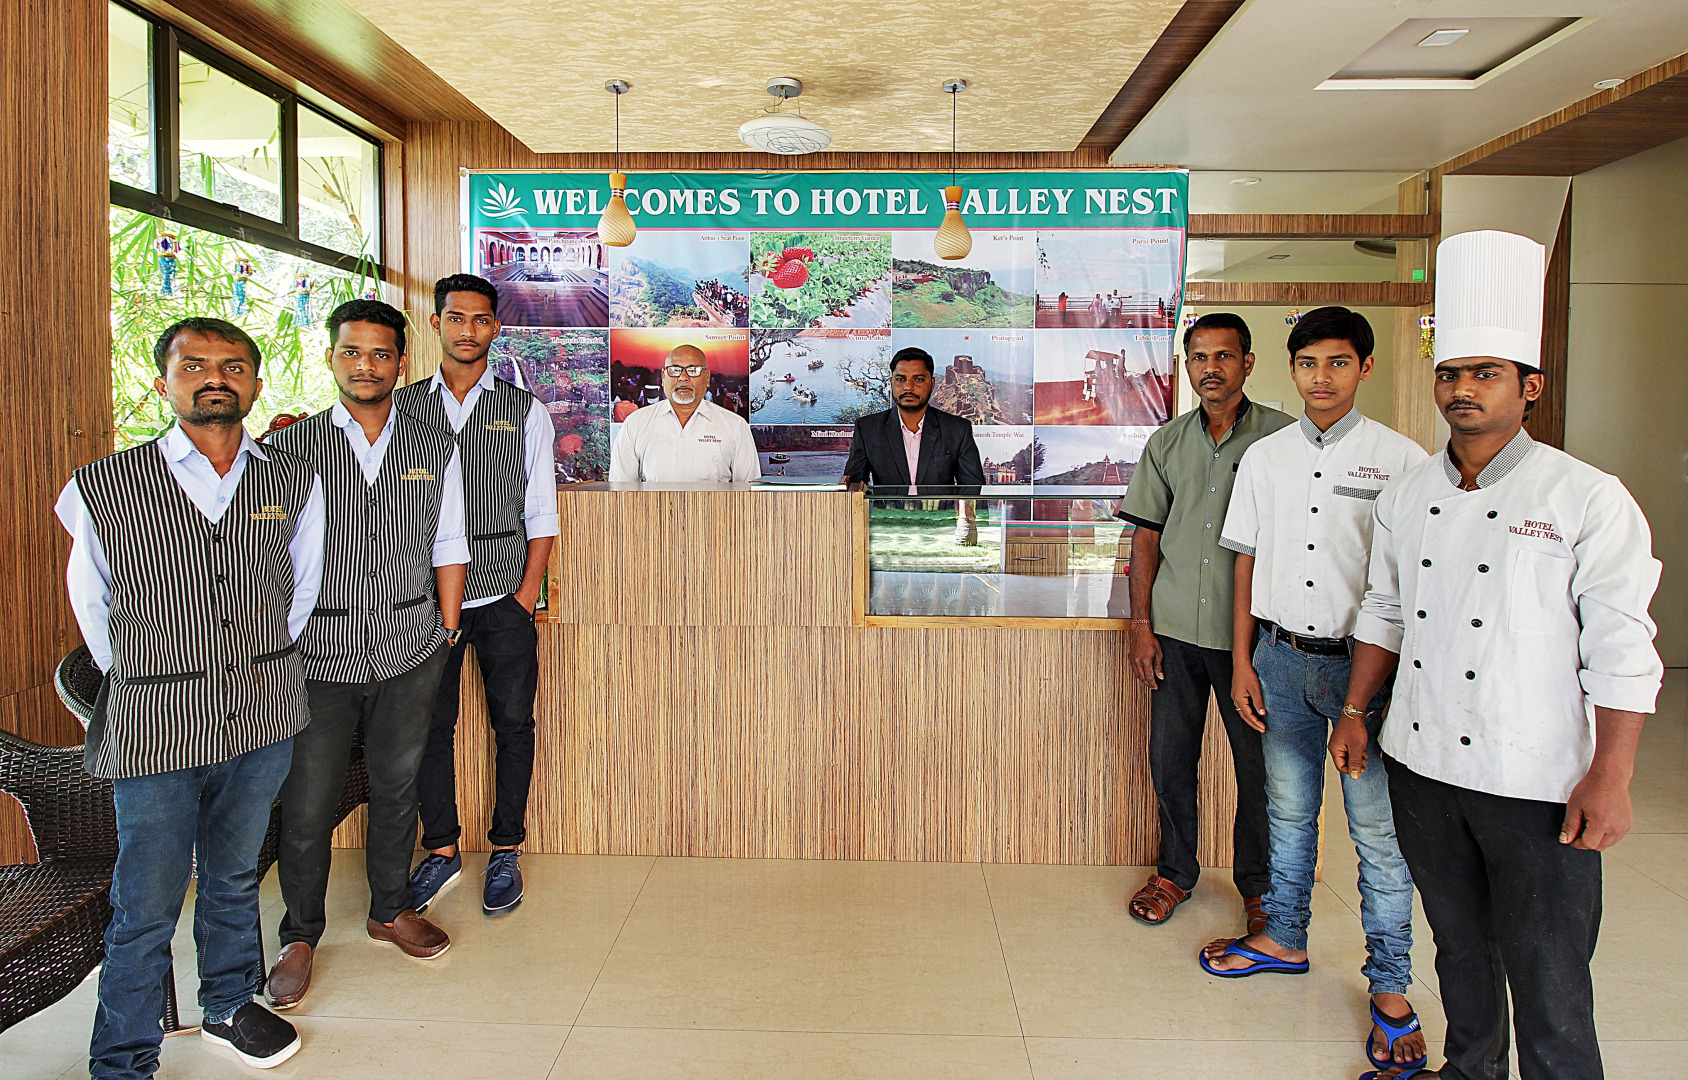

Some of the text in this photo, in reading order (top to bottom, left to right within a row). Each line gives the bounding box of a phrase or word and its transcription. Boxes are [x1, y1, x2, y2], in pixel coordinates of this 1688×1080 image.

[751, 188, 800, 215] TO
[810, 188, 929, 215] HOTEL
[1084, 187, 1179, 215] NEST
[811, 430, 828, 438] Mini
[1347, 471, 1371, 479] VALLEY
[1524, 520, 1554, 531] HOTEL
[1508, 526, 1564, 543] VALLEY NEST
